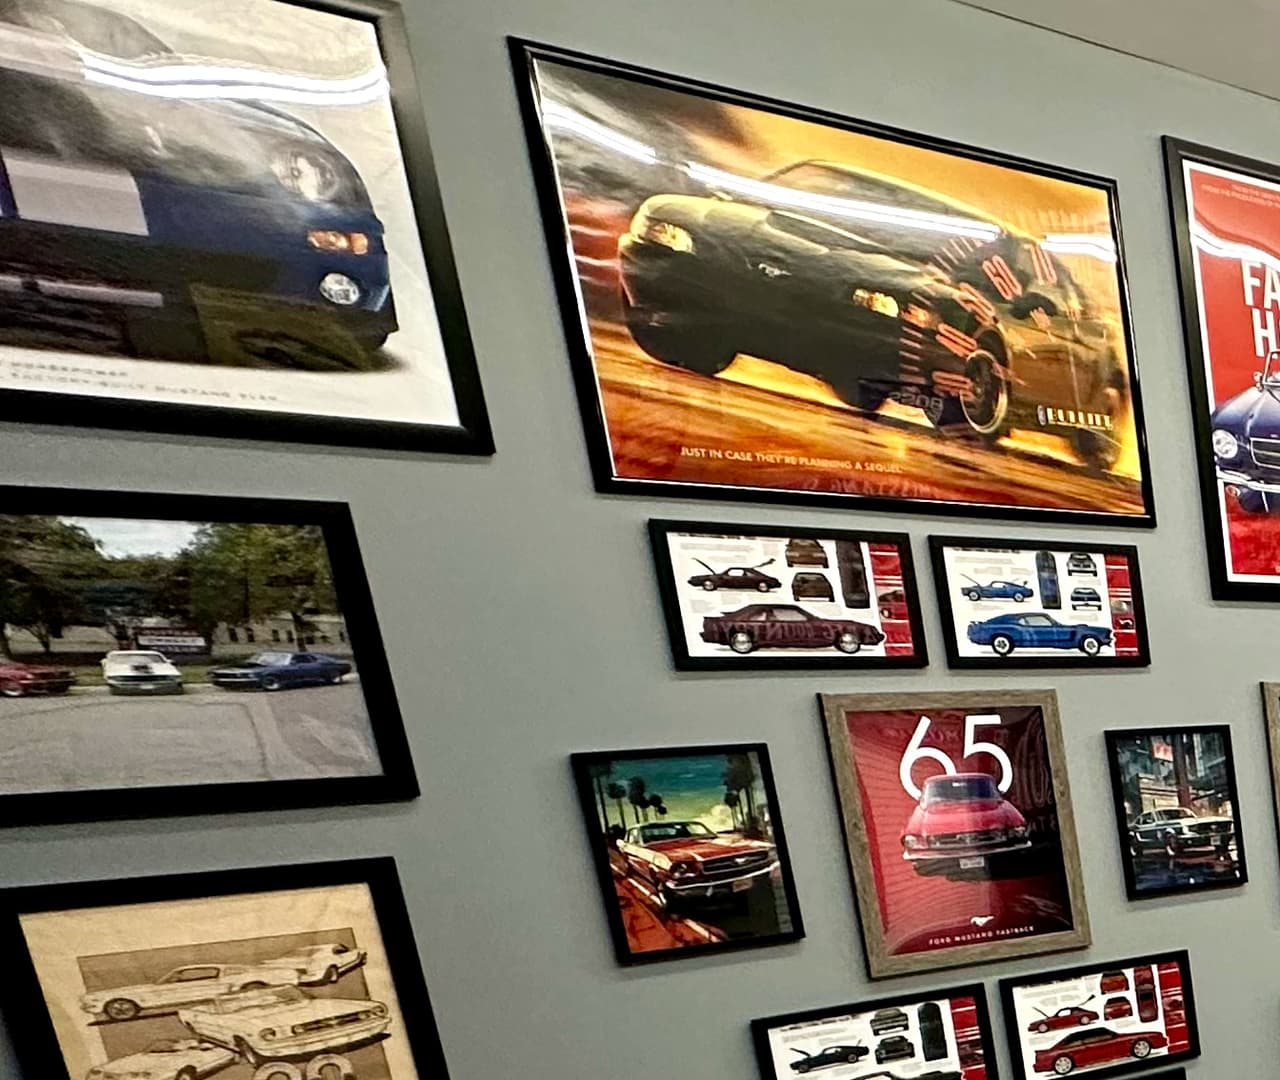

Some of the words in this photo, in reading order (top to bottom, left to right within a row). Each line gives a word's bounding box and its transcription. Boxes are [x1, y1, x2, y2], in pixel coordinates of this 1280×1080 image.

[681, 446, 706, 458] JUST
[709, 448, 723, 459] IN
[724, 450, 753, 461] CASE
[855, 461, 863, 470] A
[899, 714, 1013, 801] 65
[928, 937, 951, 946] FORD
[954, 931, 993, 942] MUSTANG
